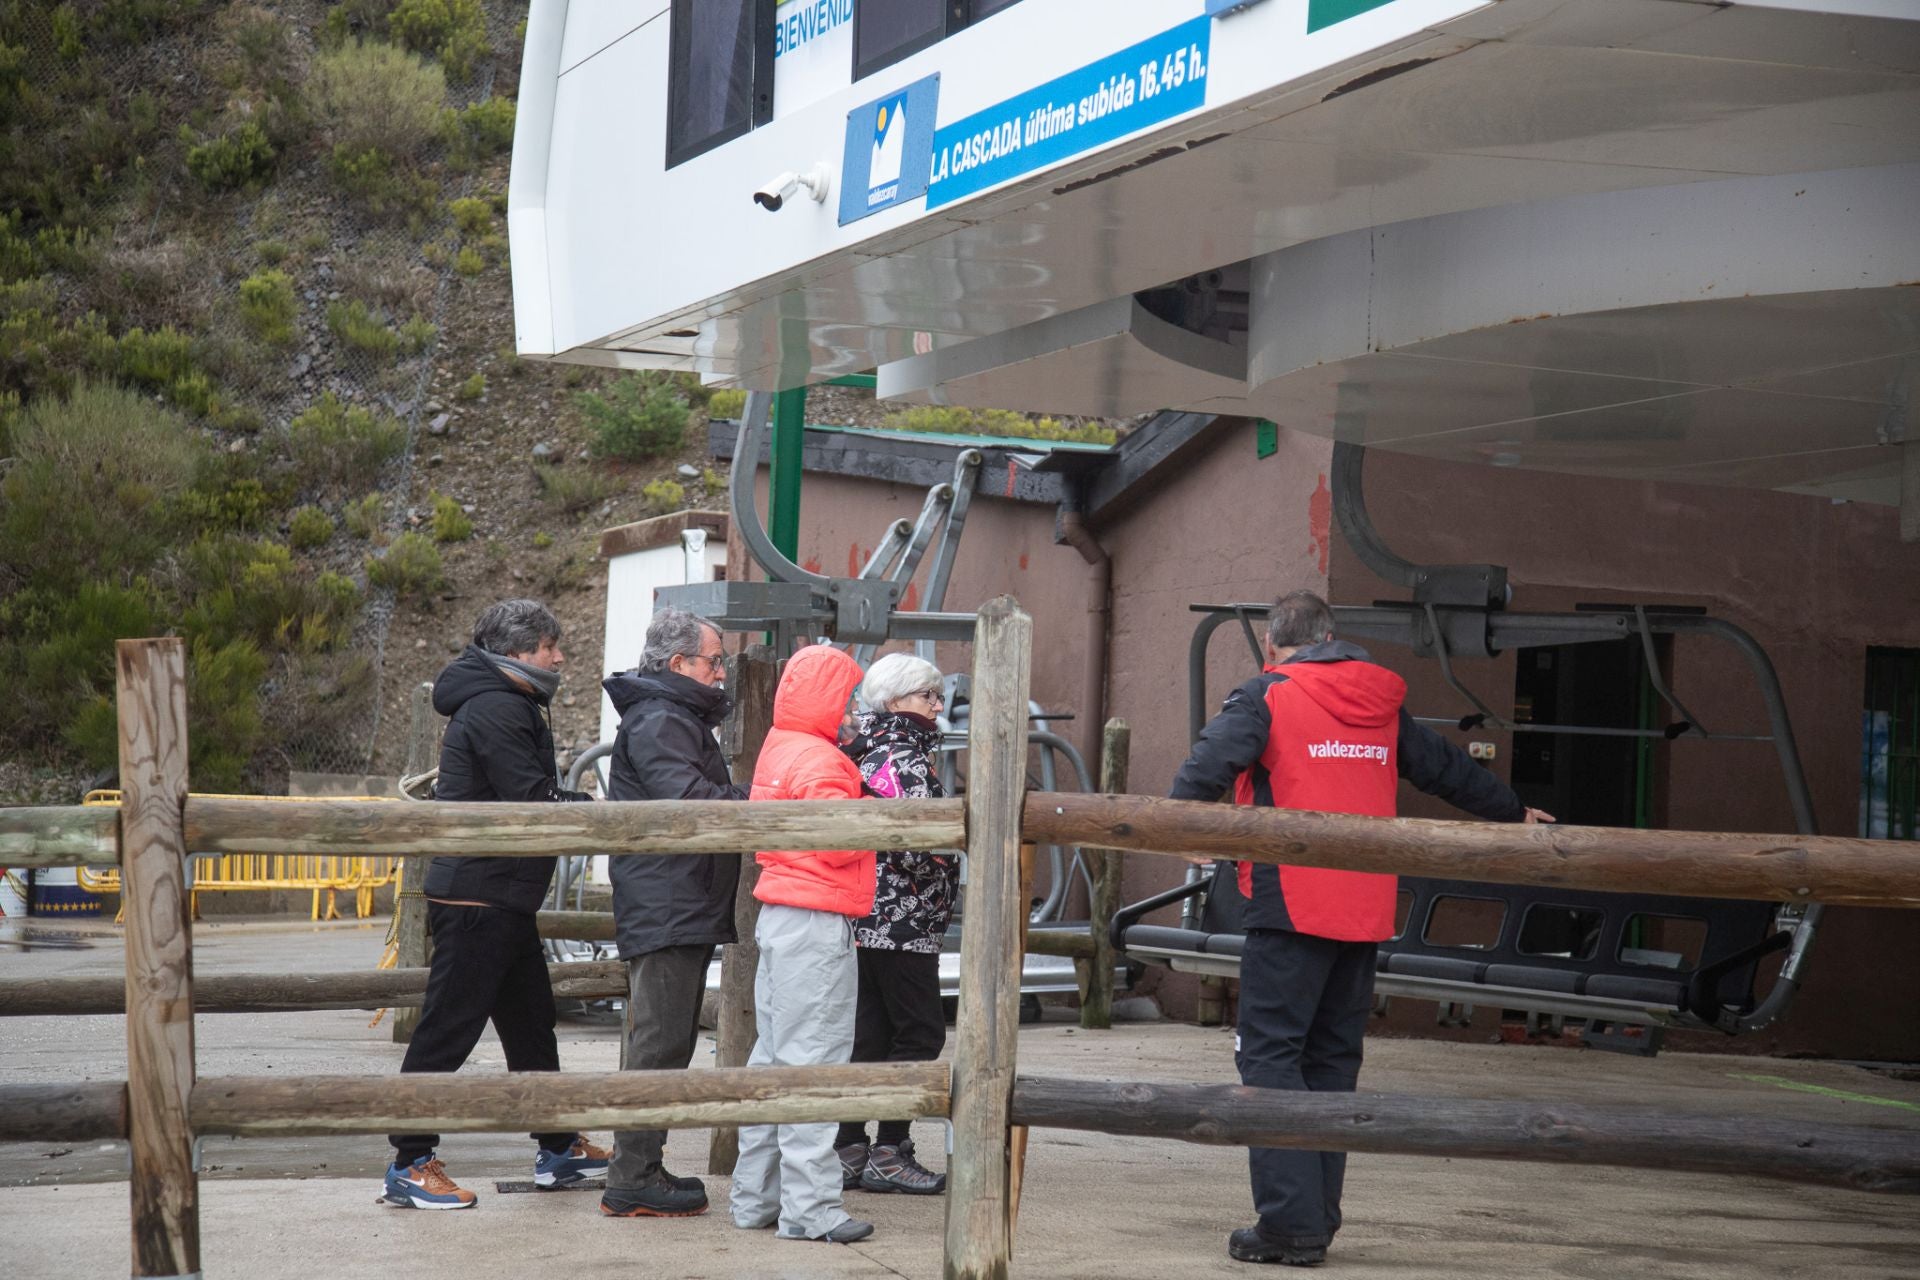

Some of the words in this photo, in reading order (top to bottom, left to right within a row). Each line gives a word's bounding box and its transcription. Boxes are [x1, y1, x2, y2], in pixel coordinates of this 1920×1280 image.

[929, 147, 949, 184] LA
[951, 117, 1021, 175] CASCADA
[1024, 102, 1075, 147] última
[1077, 72, 1135, 125] subida
[1138, 47, 1187, 101] 16.45
[1188, 43, 1206, 82] h.
[1308, 740, 1389, 765] valdezcaray
